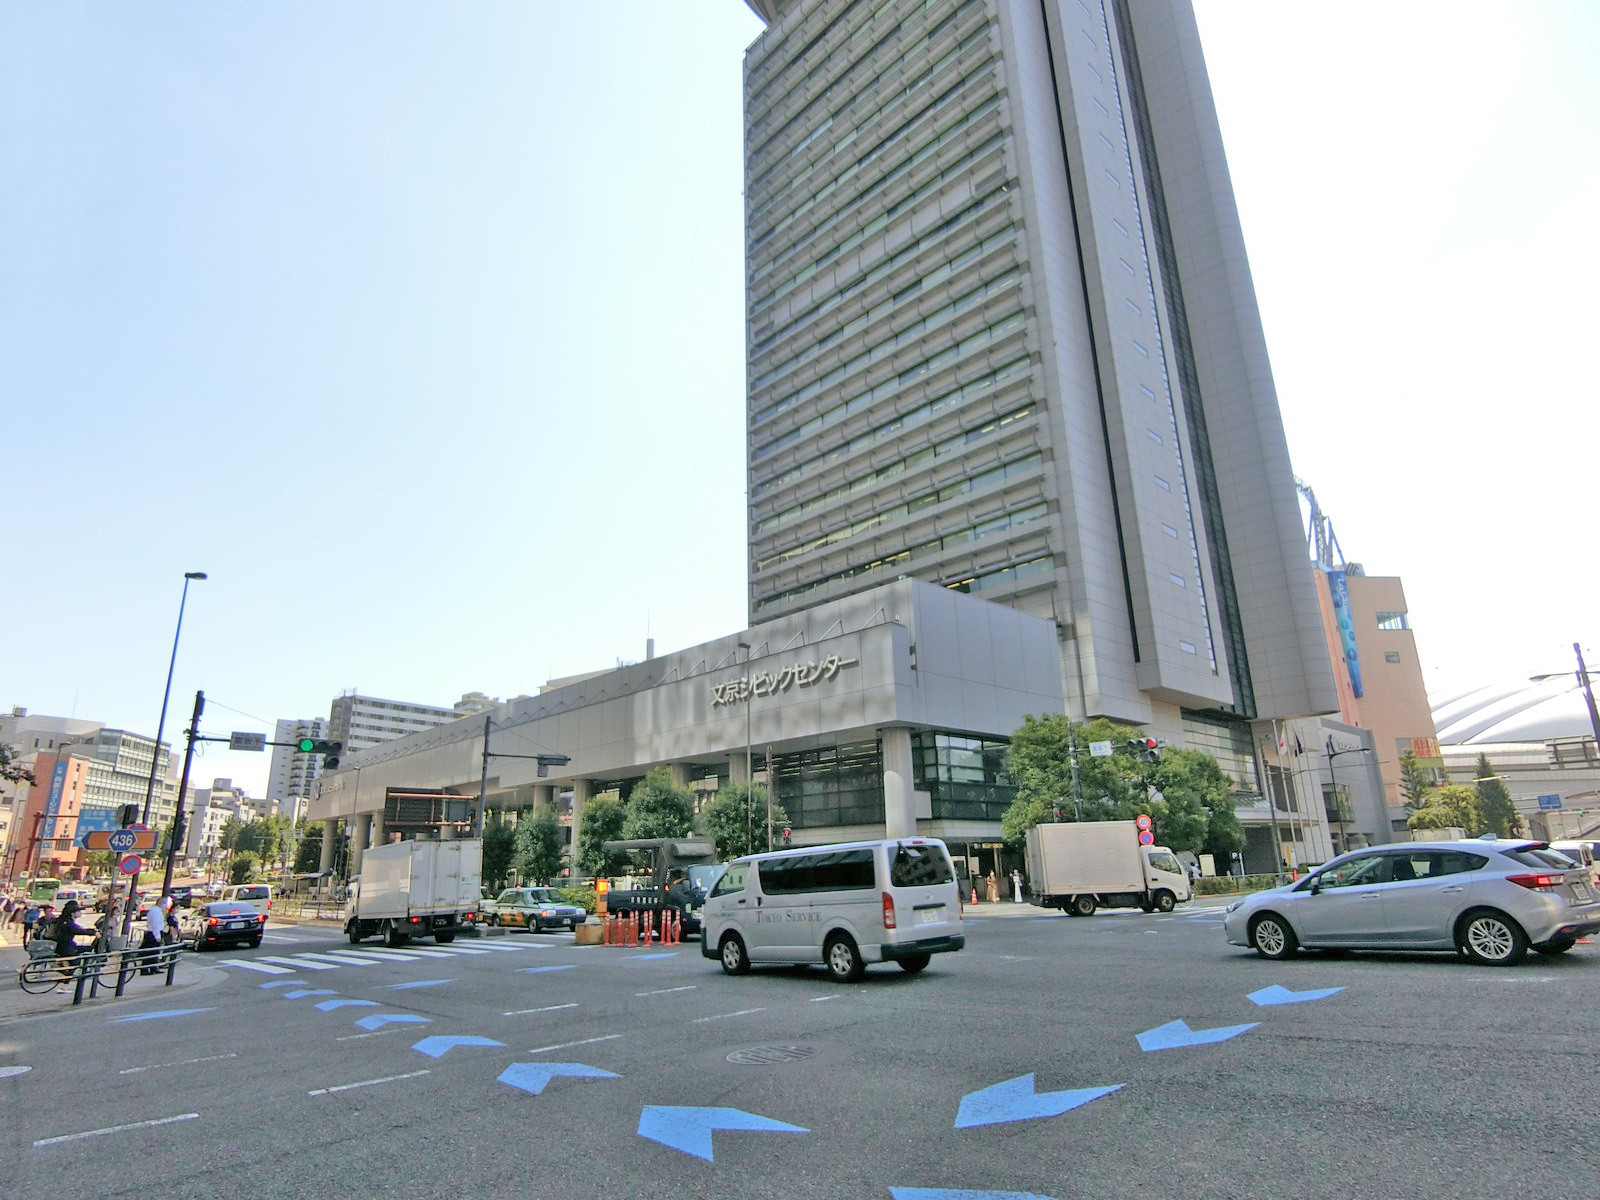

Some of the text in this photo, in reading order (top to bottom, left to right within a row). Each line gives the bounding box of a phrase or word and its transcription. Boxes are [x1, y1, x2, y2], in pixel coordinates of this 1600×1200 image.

[710, 653, 857, 706] 文京シビックセンター
[112, 834, 133, 846] 436
[756, 909, 822, 923] TOKYO SERVICE
